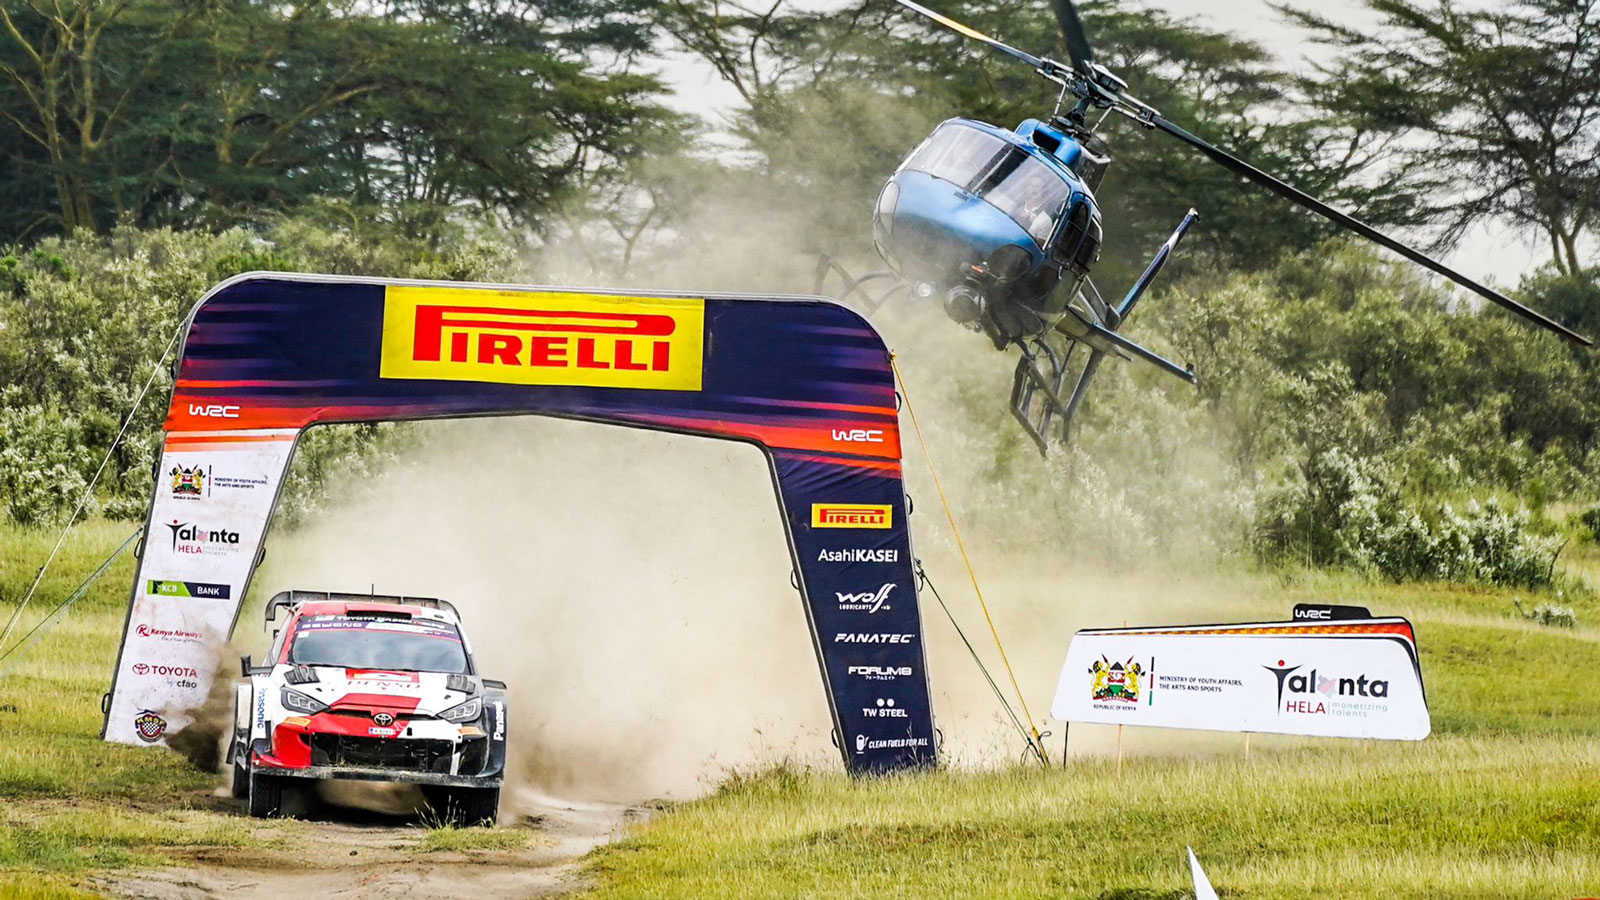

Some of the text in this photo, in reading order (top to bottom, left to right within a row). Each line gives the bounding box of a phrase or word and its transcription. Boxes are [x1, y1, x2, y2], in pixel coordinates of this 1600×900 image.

[413, 305, 676, 371] PIRELLI
[189, 403, 240, 418] WRC
[832, 429, 883, 442] WRC
[820, 508, 885, 524] PIRELLI
[178, 544, 203, 554] HELA
[818, 549, 898, 562] AsahiKASEI
[161, 584, 220, 596] KCB BANK
[1294, 608, 1332, 619] WRC
[150, 628, 173, 637] Kenya
[834, 633, 912, 643] FANATEC
[152, 665, 198, 678] TOYOTA
[848, 666, 912, 676] FORUM8
[176, 680, 197, 689] cfao
[1286, 701, 1326, 714] HELA
[1332, 702, 1388, 712] monetizing
[862, 708, 908, 718] TW STEEL
[1331, 709, 1367, 718] talents
[868, 737, 929, 749] CLEAN FUELS FOR ALL
